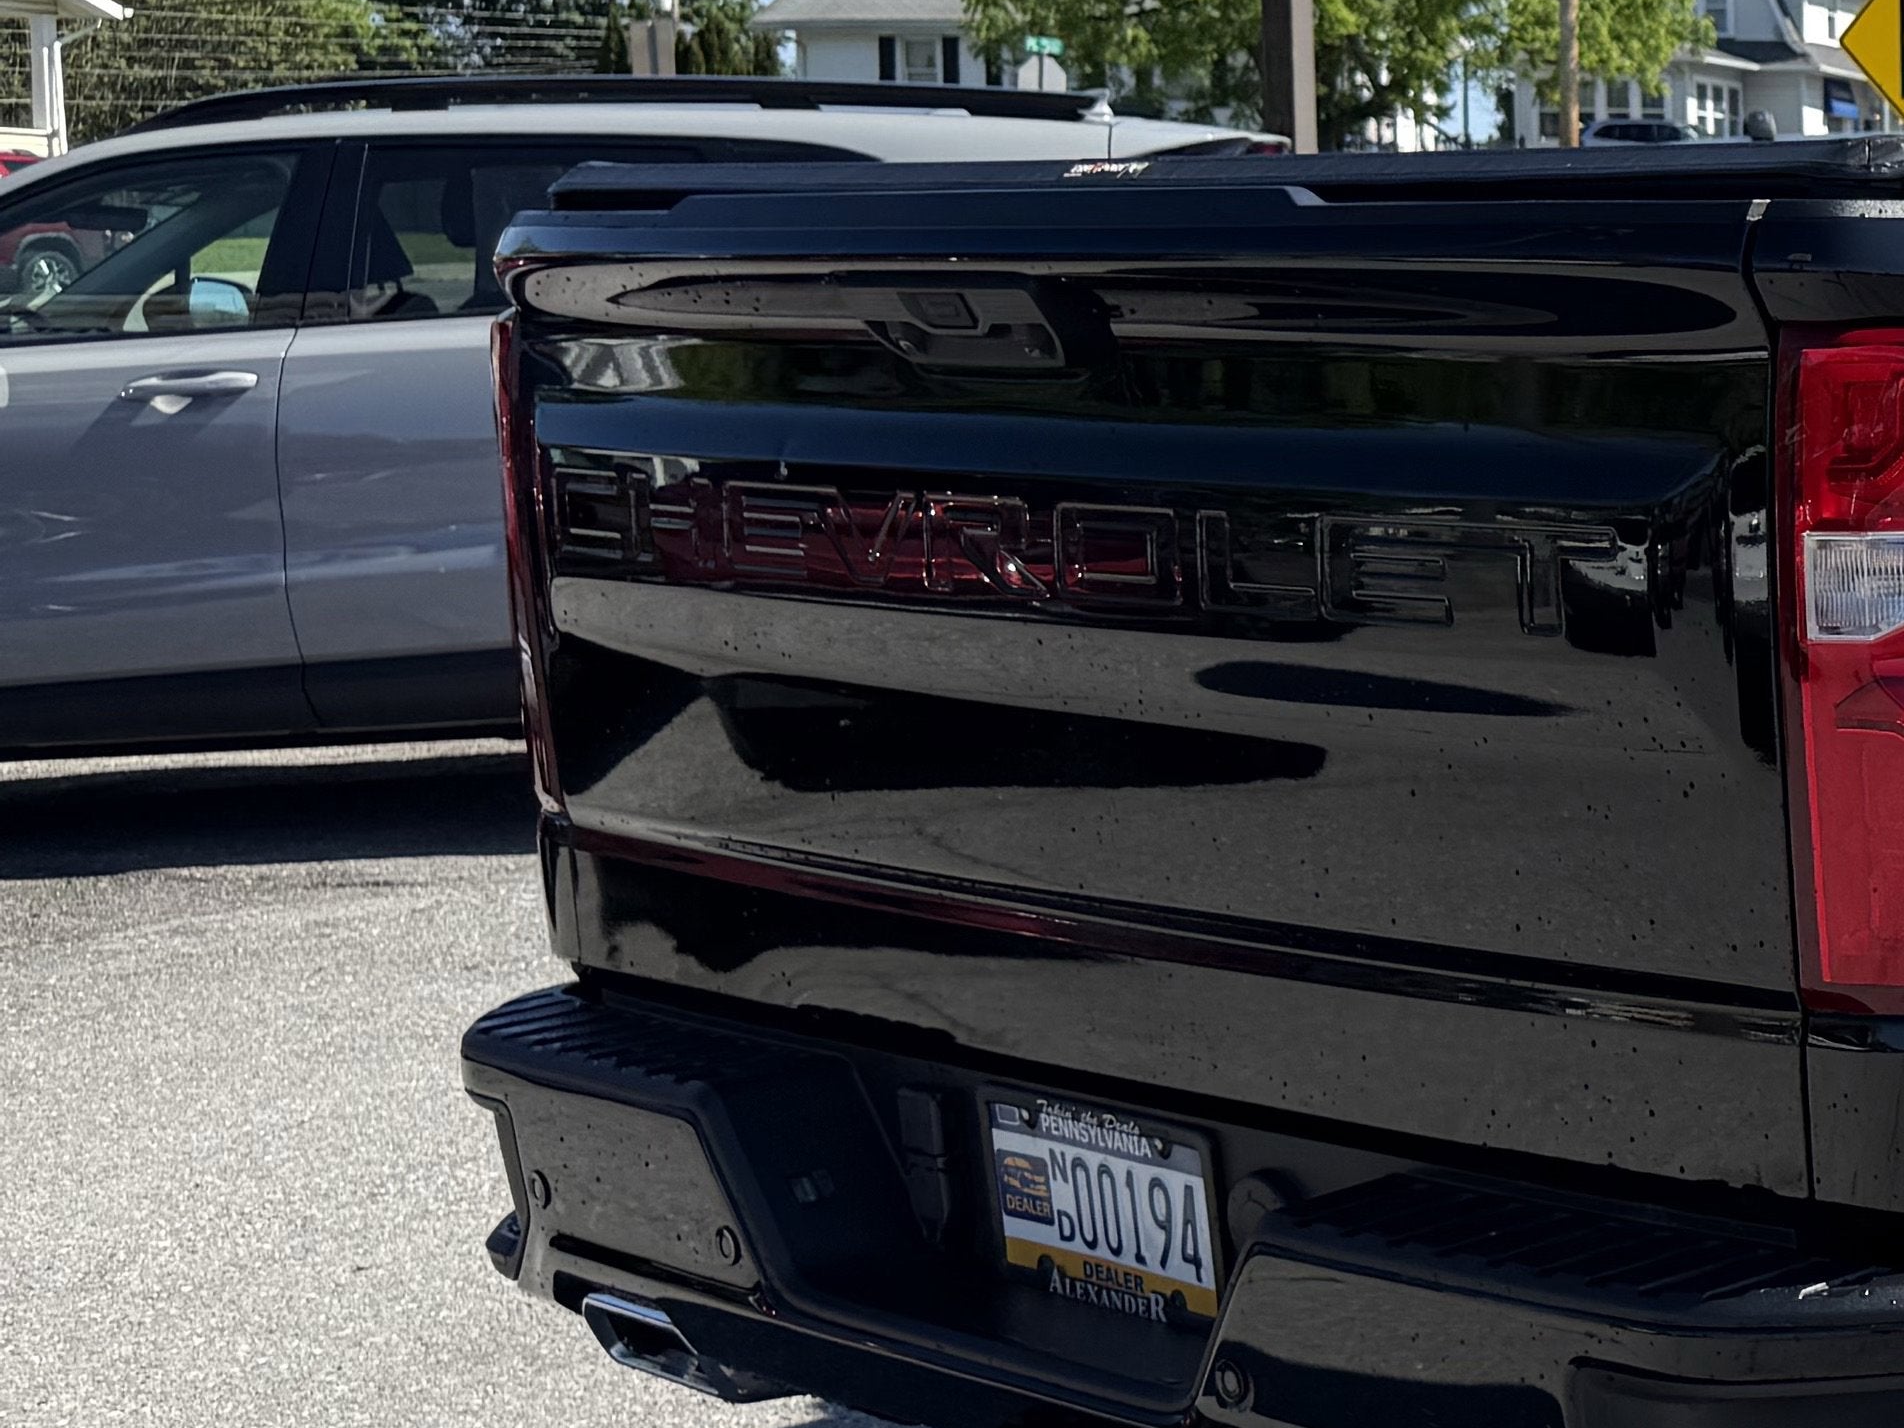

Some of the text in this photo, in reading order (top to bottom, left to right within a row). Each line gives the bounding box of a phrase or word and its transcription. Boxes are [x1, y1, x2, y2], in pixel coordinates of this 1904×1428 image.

[1039, 1112, 1152, 1159] PENNSYLVANIA
[1080, 1110, 1100, 1125] the
[1102, 1113, 1141, 1136] Deals
[1006, 1194, 1051, 1216] DEALER
[1082, 1259, 1145, 1294] DEALER
[1049, 1266, 1167, 1323] ALEXANDER
